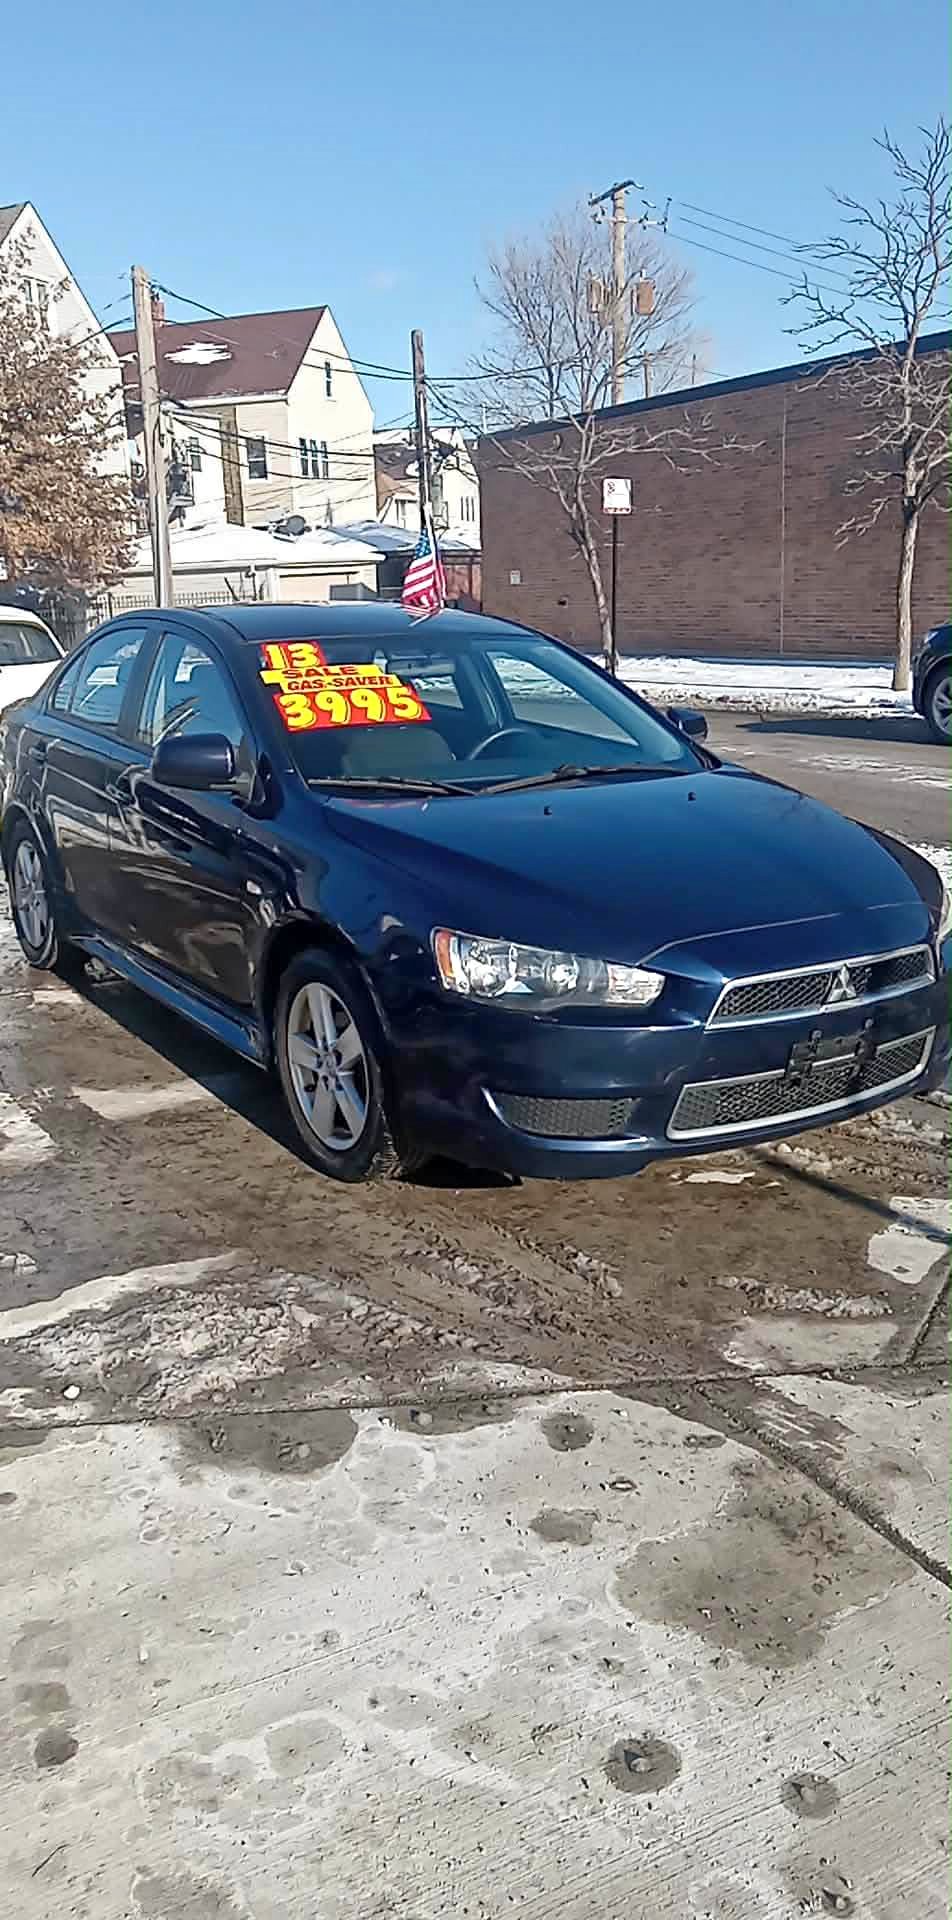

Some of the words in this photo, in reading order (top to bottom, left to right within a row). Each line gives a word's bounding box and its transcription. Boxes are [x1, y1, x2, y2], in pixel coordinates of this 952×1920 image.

[265, 643, 320, 669] 13
[282, 666, 361, 679] SALE
[279, 686, 422, 729] 3995
